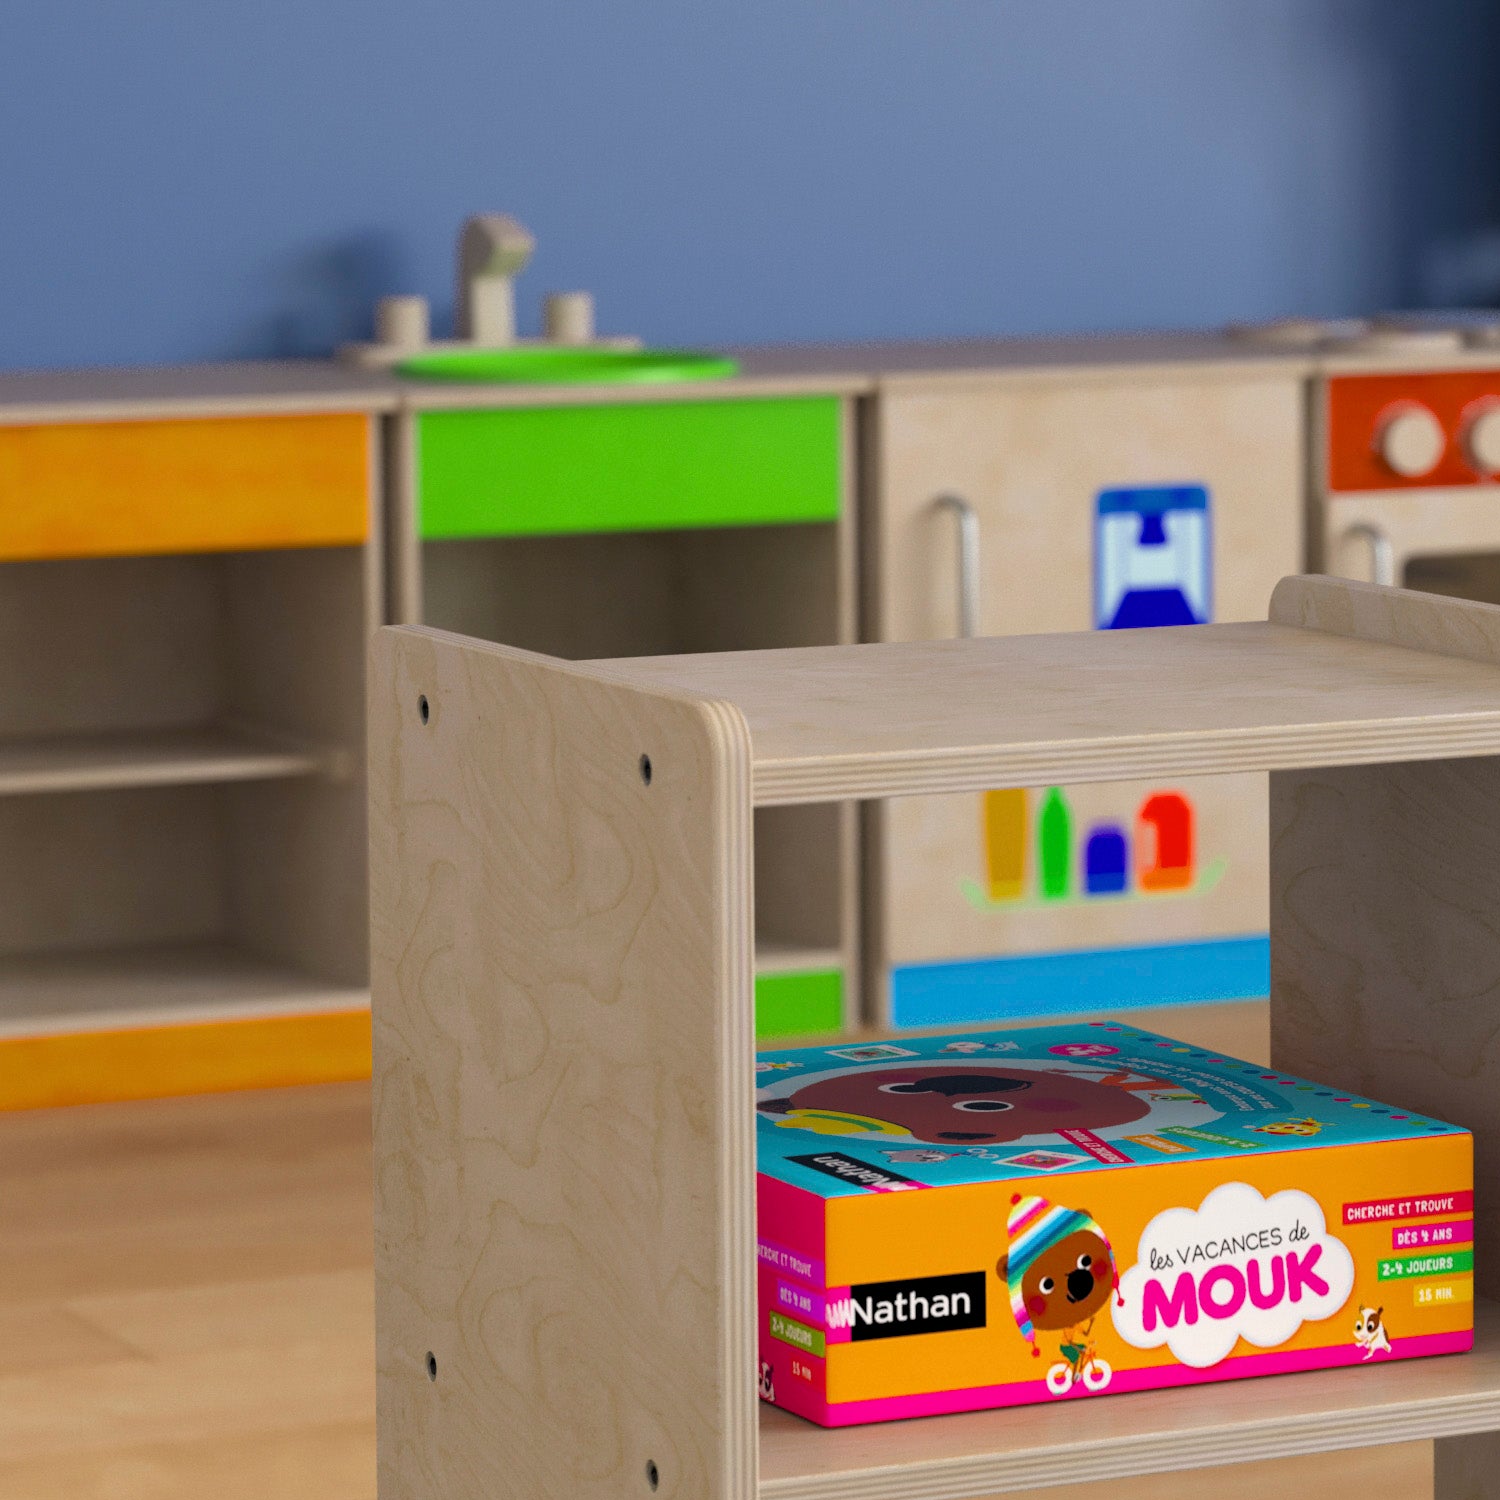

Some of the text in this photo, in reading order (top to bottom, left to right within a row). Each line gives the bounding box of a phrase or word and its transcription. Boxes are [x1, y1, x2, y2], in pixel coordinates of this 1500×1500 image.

[813, 1155, 905, 1190] Nathan
[1347, 1197, 1454, 1221] CHERCHE ET TROUVE
[1150, 1218, 1310, 1271] les VACANCES de
[1397, 1227, 1453, 1246] DÈS 4 ANS
[780, 1253, 788, 1267] ET
[1382, 1256, 1454, 1277] 2-4 JOUEURS
[1142, 1243, 1330, 1332] MOUK
[849, 1290, 971, 1327] Nathan
